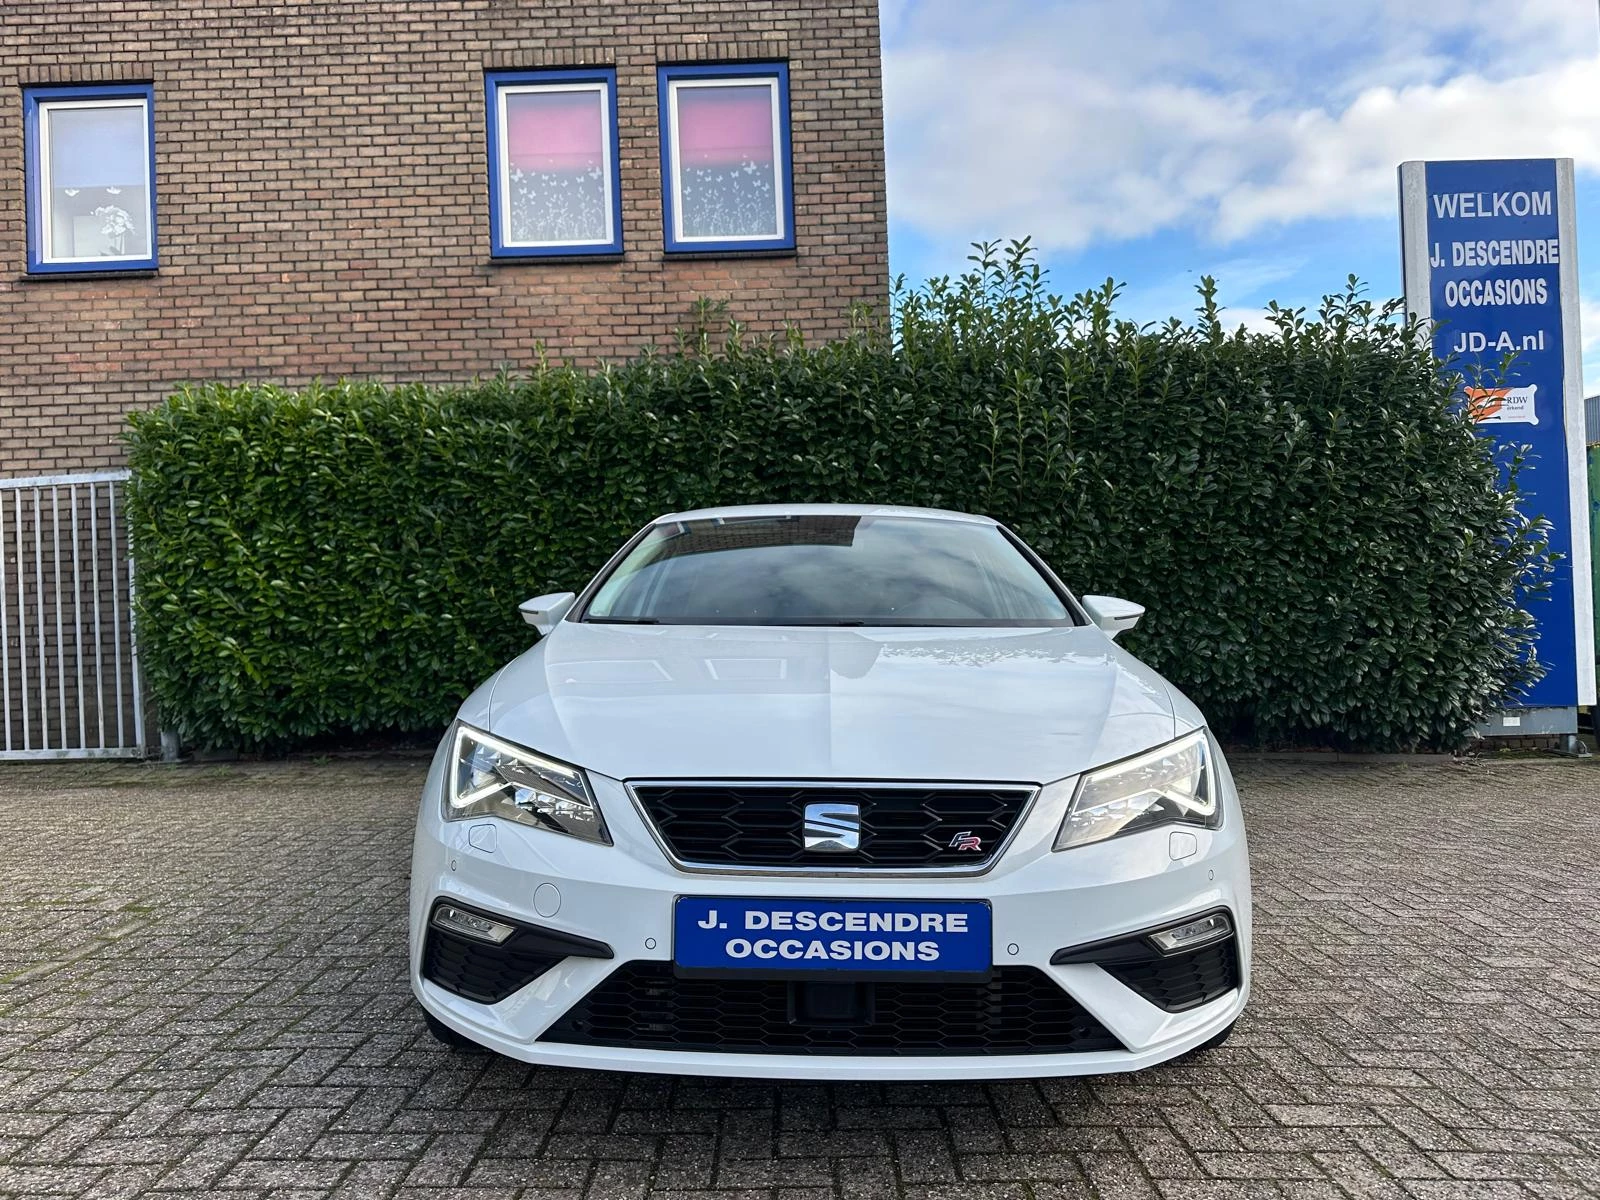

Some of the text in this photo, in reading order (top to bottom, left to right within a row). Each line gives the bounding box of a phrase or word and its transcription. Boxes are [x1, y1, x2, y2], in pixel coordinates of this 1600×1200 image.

[1433, 191, 1551, 218] WELKOM
[1430, 239, 1560, 268] J. DESCENDRE
[1444, 278, 1548, 307] OCCASIONS
[1453, 330, 1545, 353] JD-A.nl
[697, 910, 969, 933] J. DESCENDRE
[725, 938, 940, 962] OCCASIONS
